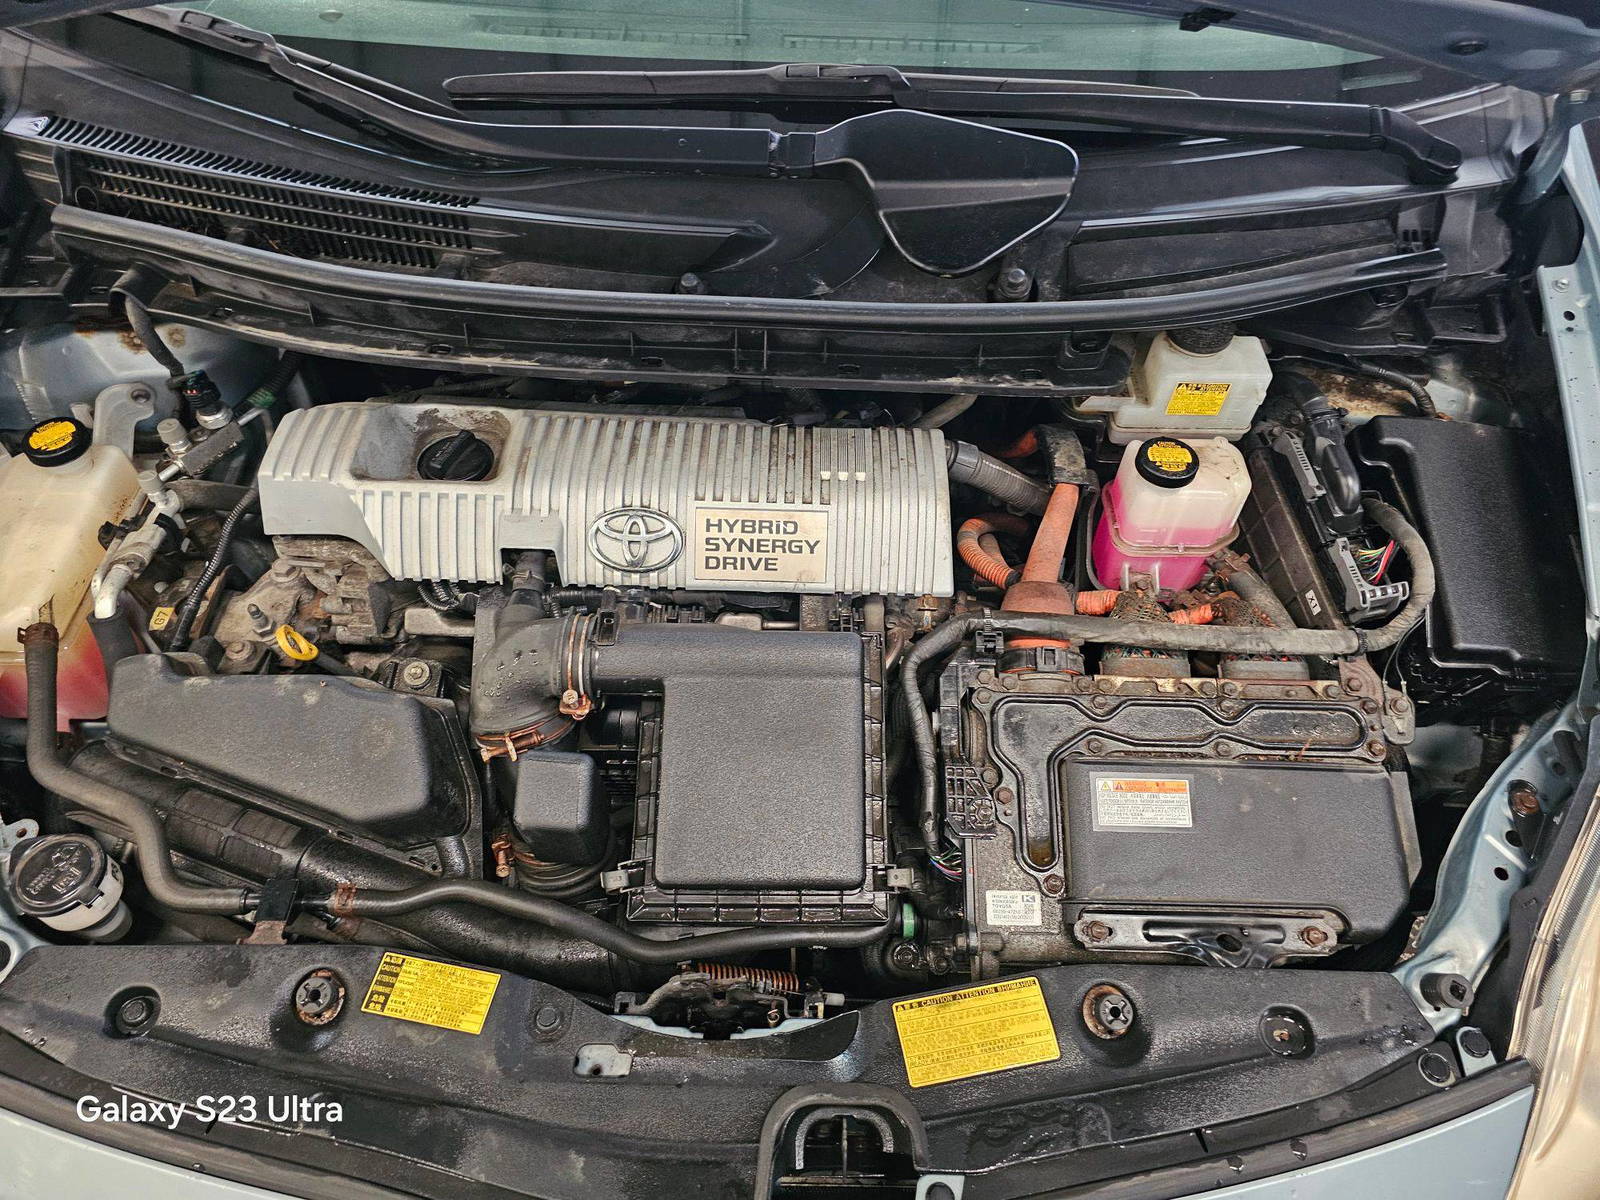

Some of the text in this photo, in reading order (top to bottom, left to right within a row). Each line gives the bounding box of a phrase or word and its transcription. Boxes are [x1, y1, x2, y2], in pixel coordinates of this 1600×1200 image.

[704, 537, 821, 555] SYNERGY
[704, 556, 779, 571] DRIVE
[921, 996, 953, 1007] CAUTION
[955, 986, 995, 1001] ATTENTION
